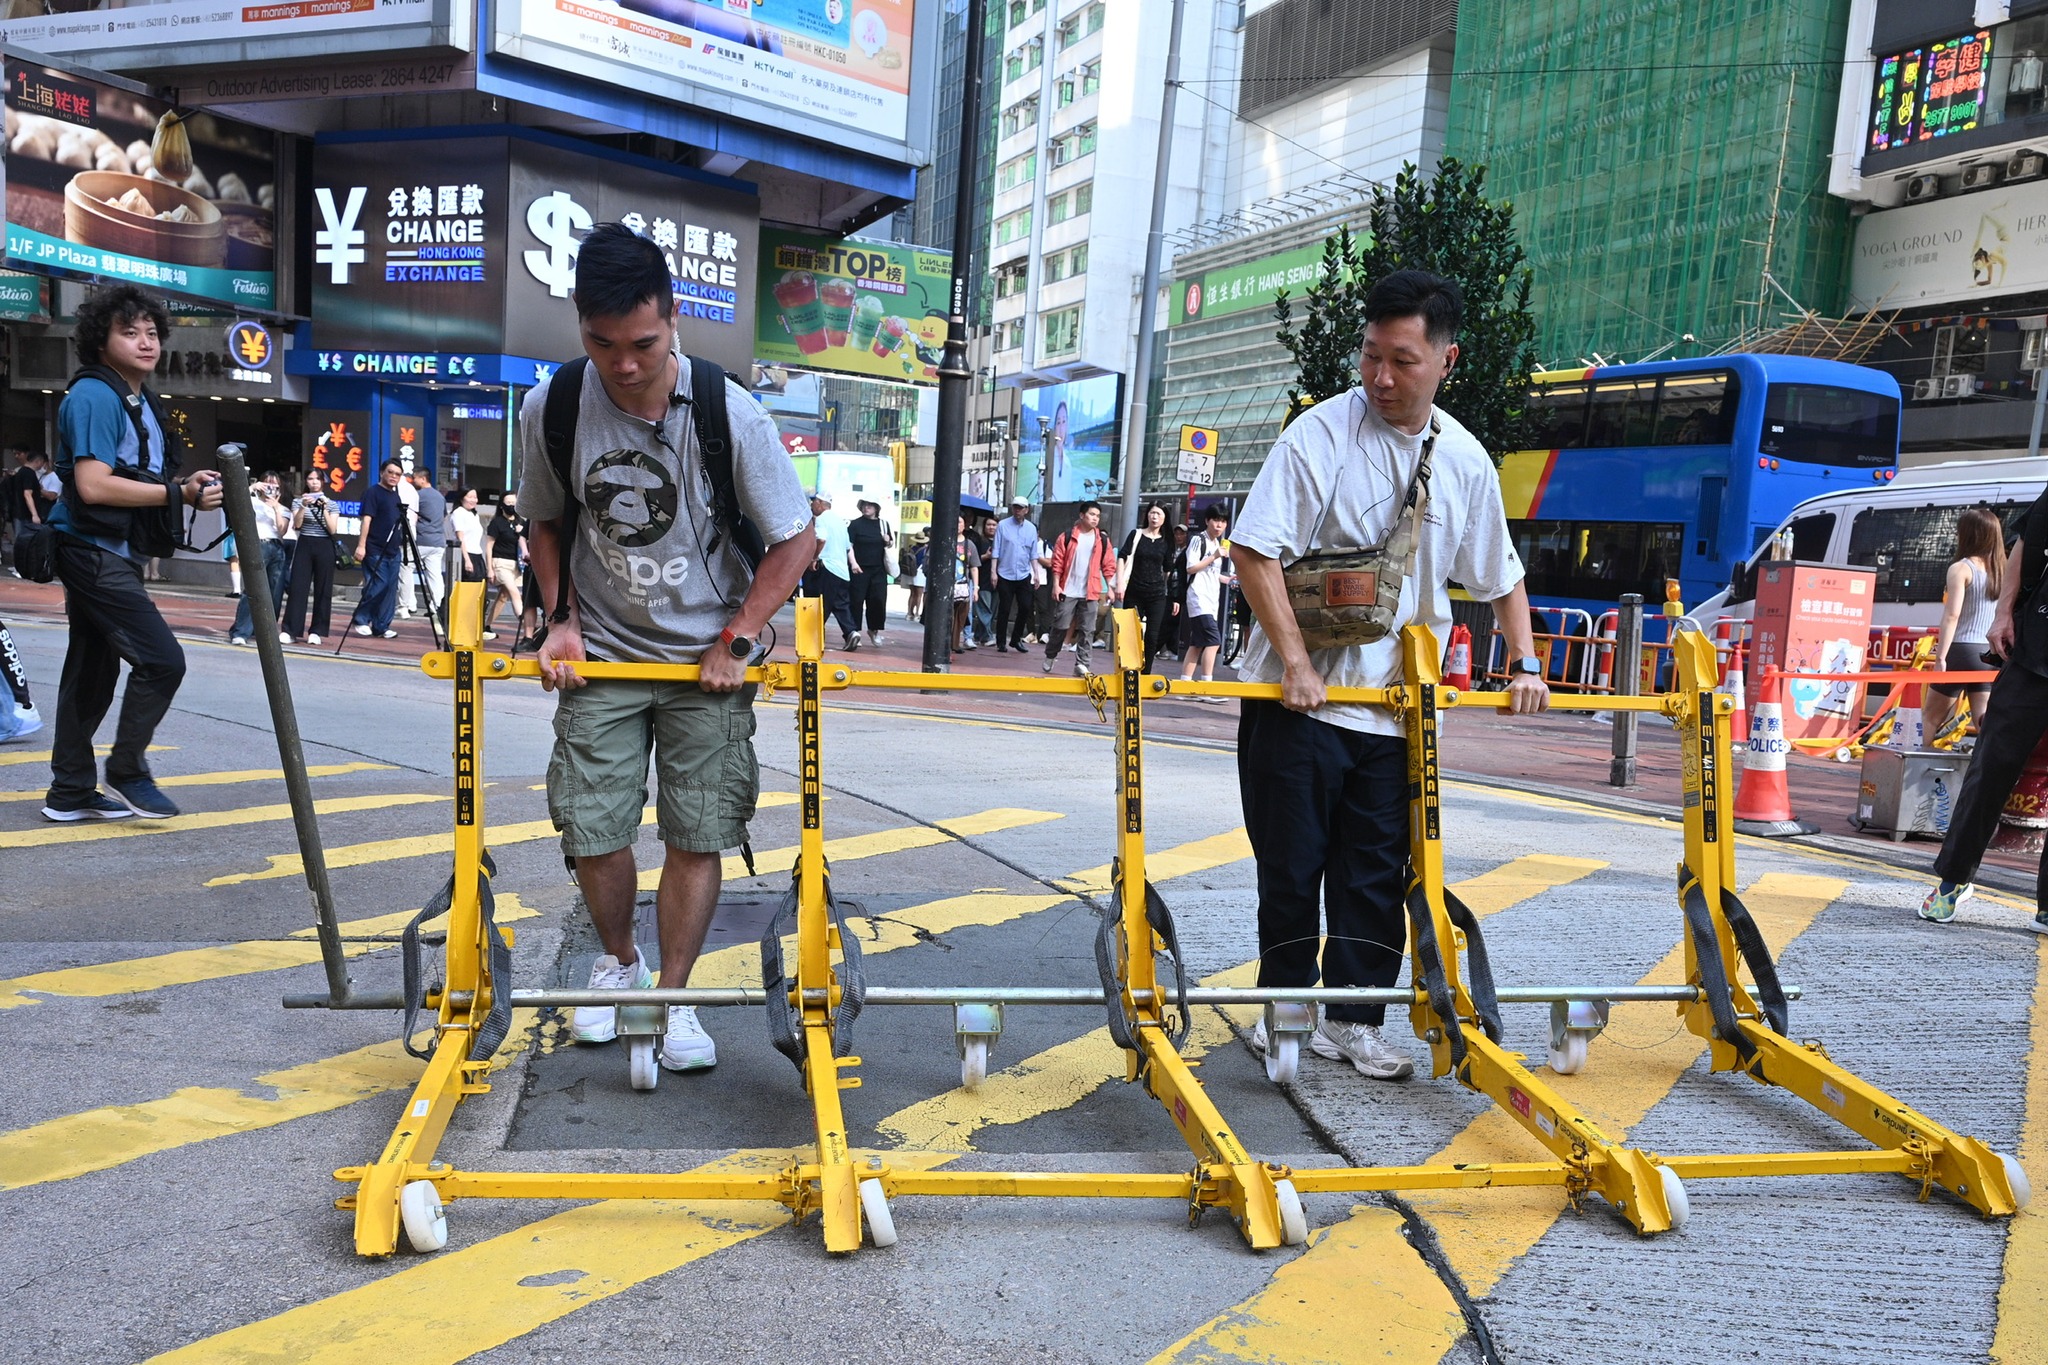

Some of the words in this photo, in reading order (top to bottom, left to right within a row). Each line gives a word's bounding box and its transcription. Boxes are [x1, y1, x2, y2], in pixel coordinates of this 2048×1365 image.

[261, 4, 301, 19] mannings
[311, 0, 351, 15] mannings
[576, 7, 619, 27] mannings
[629, 21, 670, 41] mannings
[813, 43, 847, 65] HKC-01050
[207, 79, 257, 98] Outdoor
[260, 73, 329, 95] Advertising
[334, 71, 377, 90] Lease:
[381, 67, 415, 87] 2864
[419, 64, 454, 84] 4247
[776, 67, 794, 80] mall
[18, 80, 90, 118] 上海姥姥
[18, 101, 54, 115] SHANGHAI
[58, 112, 72, 120] LAO
[76, 117, 90, 125] LAO
[1950, 100, 1978, 121] 9007
[385, 219, 485, 244] CHANGE
[418, 246, 449, 259] HONG
[449, 246, 485, 260] KONG
[1862, 242, 1898, 259] YOGA
[1902, 229, 1963, 252] GROUND
[10, 238, 33, 255] 1/F
[36, 241, 56, 258] JP
[58, 250, 97, 268] Plaza
[101, 254, 187, 286] 翡翠明珠廣場
[666, 252, 737, 288] ANGE
[777, 250, 831, 273] 銅鑼灣
[828, 248, 886, 279] TOP
[886, 266, 902, 283] 榜
[385, 265, 486, 283] EXCHANGE
[1206, 275, 1256, 307] 恒生銀行
[1258, 271, 1284, 293] HANG
[1286, 262, 1313, 286] SENG
[0, 286, 33, 302] stiva
[232, 278, 270, 297] Festiva
[671, 280, 698, 296] ONG
[699, 285, 737, 304] KONG
[953, 278, 964, 315] 50239
[678, 300, 736, 325] ANGE
[353, 353, 438, 375] CHANGE
[1202, 456, 1208, 467] 7
[1200, 473, 1211, 484] 12
[1343, 577, 1361, 585] BEST
[0, 629, 26, 687] adidas
[1753, 716, 1780, 732] 警察
[1881, 1115, 1908, 1135] GROUND
